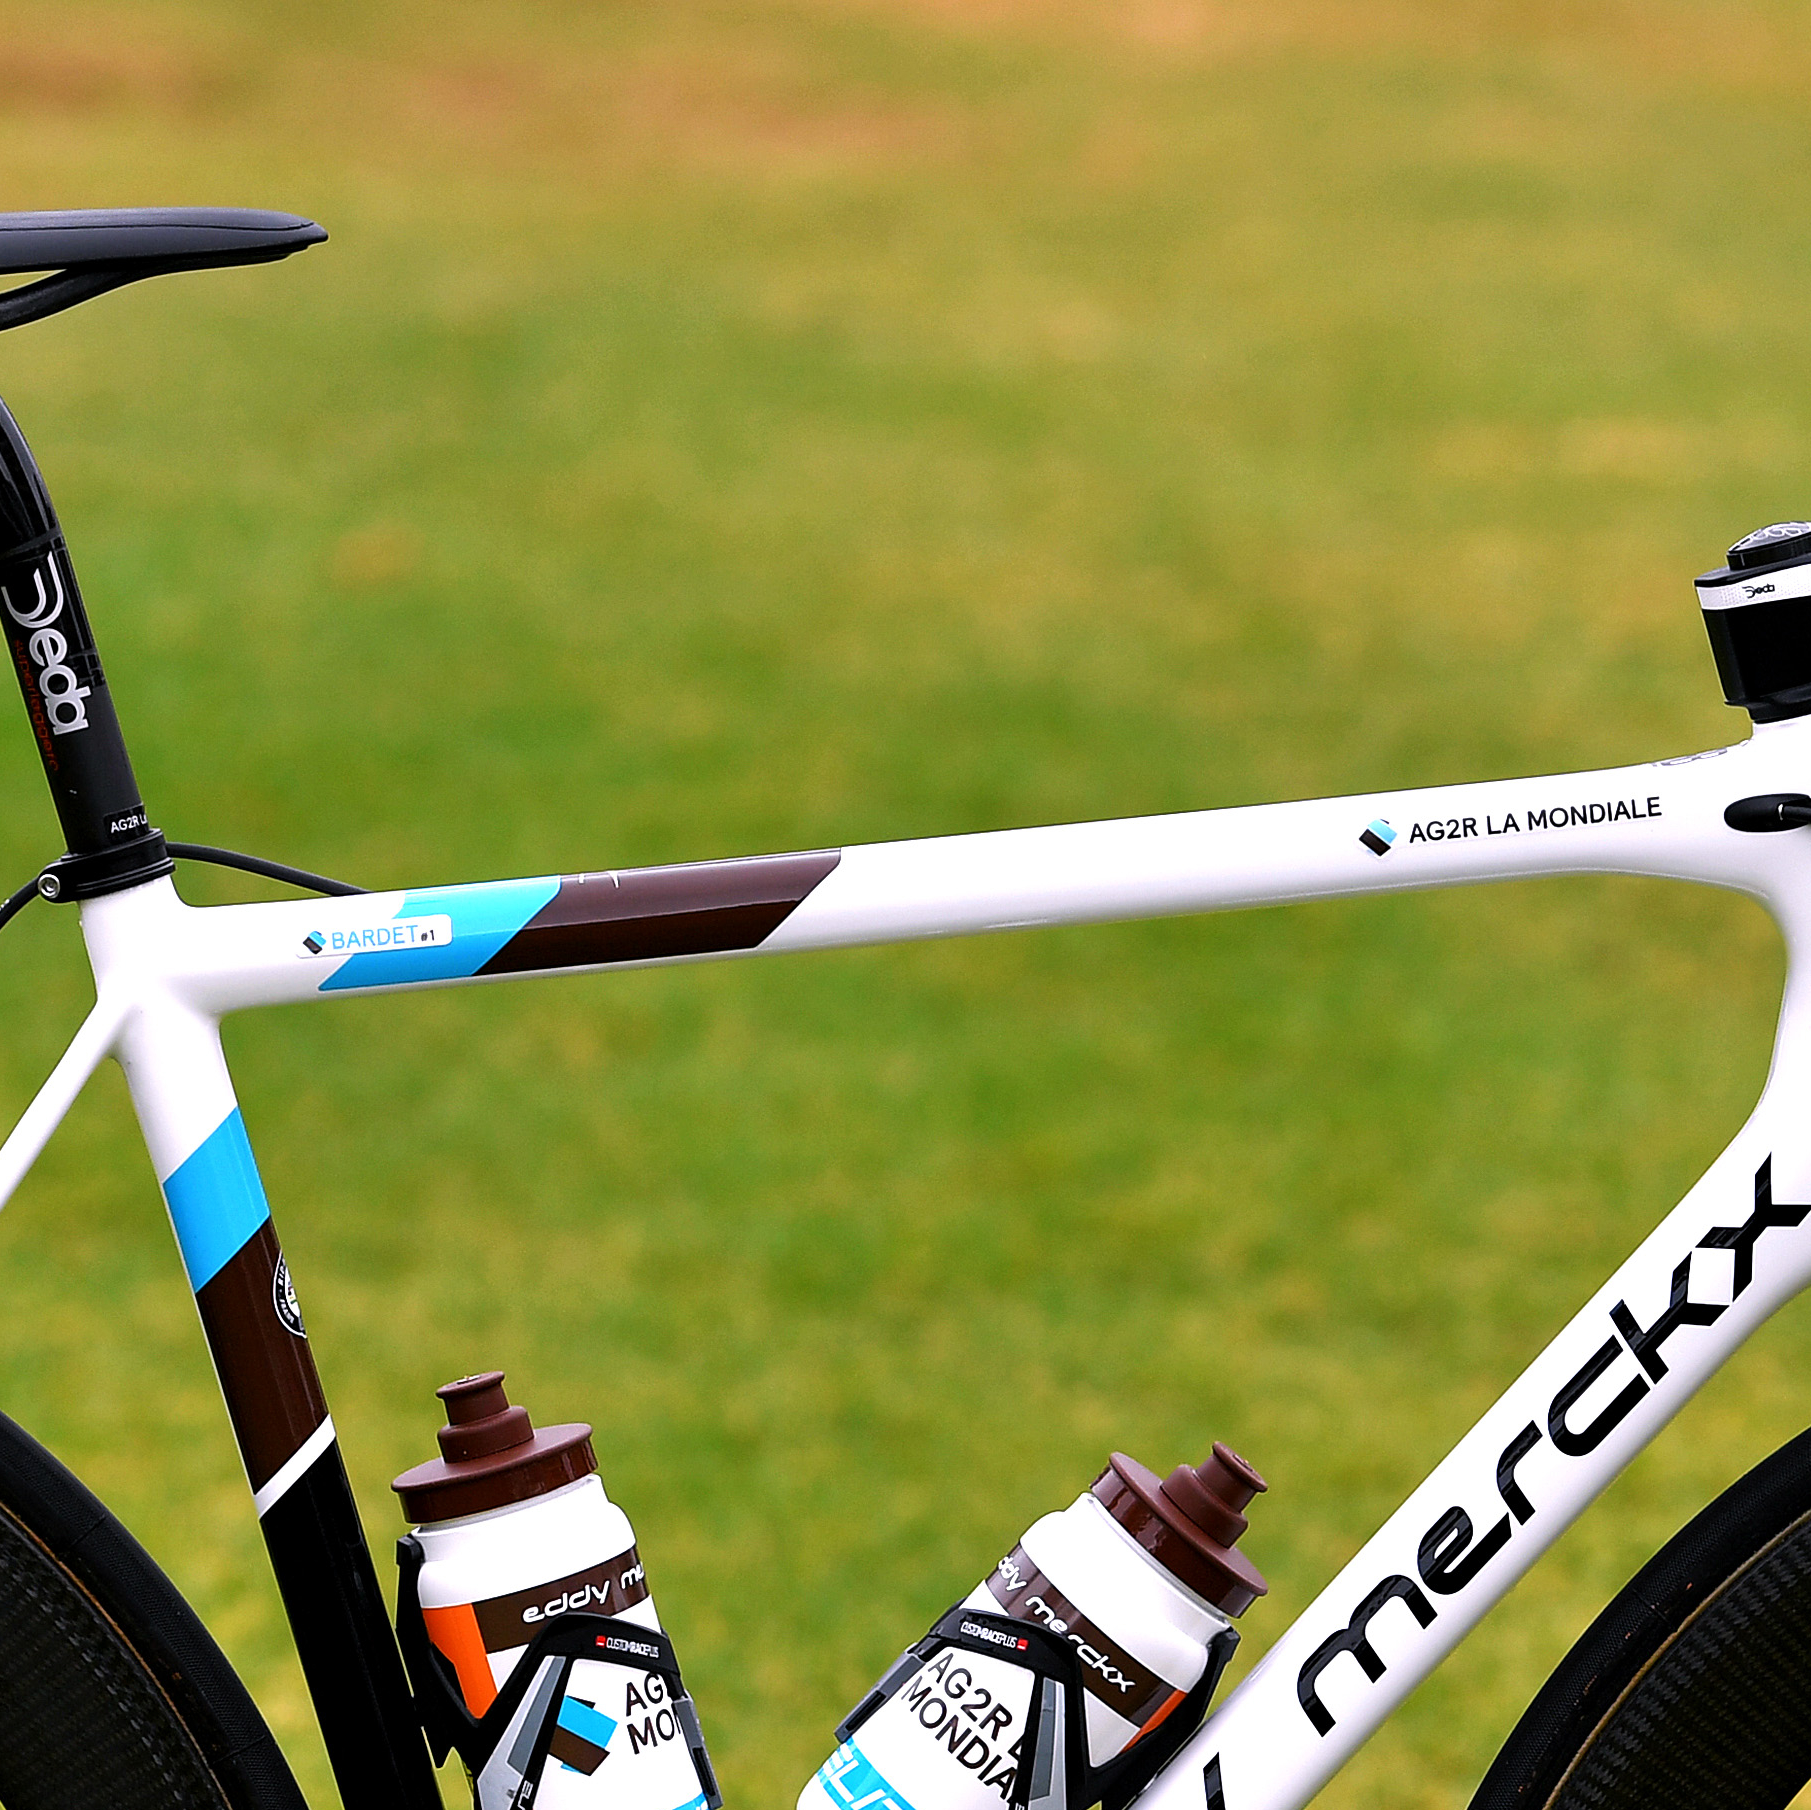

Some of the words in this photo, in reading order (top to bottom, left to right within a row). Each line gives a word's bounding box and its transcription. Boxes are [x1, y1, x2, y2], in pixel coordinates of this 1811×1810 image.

[1, 551, 91, 735] Deda
[111, 815, 141, 833] AG2R
[1409, 817, 1479, 844] AG2R
[1486, 813, 1521, 835] LA
[1527, 796, 1663, 831] MONDIALE
[331, 924, 420, 952] BARDET
[420, 928, 436, 943] #1
[522, 1580, 610, 1624] eddy
[1025, 1597, 1135, 1694] merckx
[927, 1653, 1013, 1742] AG2R
